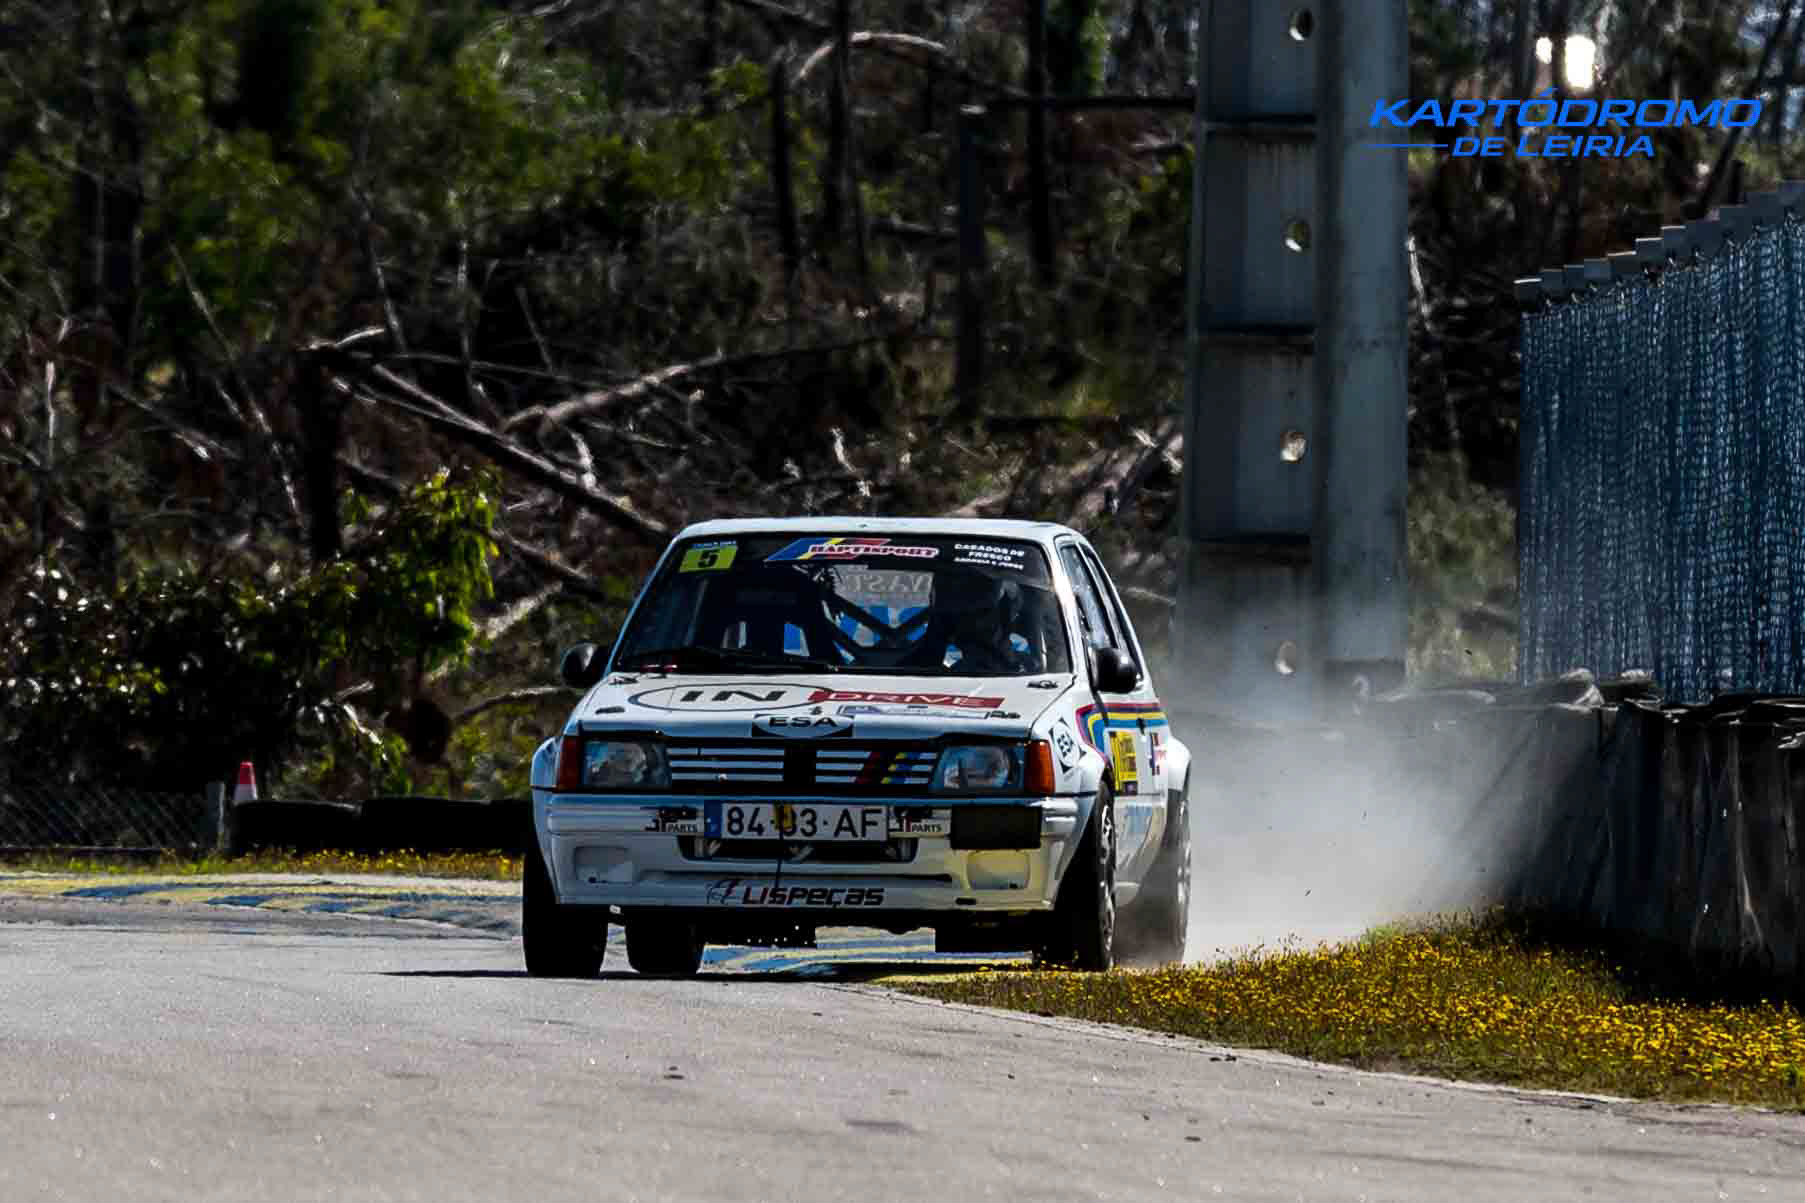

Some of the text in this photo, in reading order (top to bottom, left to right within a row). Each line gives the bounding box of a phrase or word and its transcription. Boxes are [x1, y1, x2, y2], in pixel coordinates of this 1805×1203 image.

[697, 550, 720, 569] 5
[680, 690, 788, 702] IN
[829, 692, 984, 707] DRIVE
[769, 717, 838, 728] ESA
